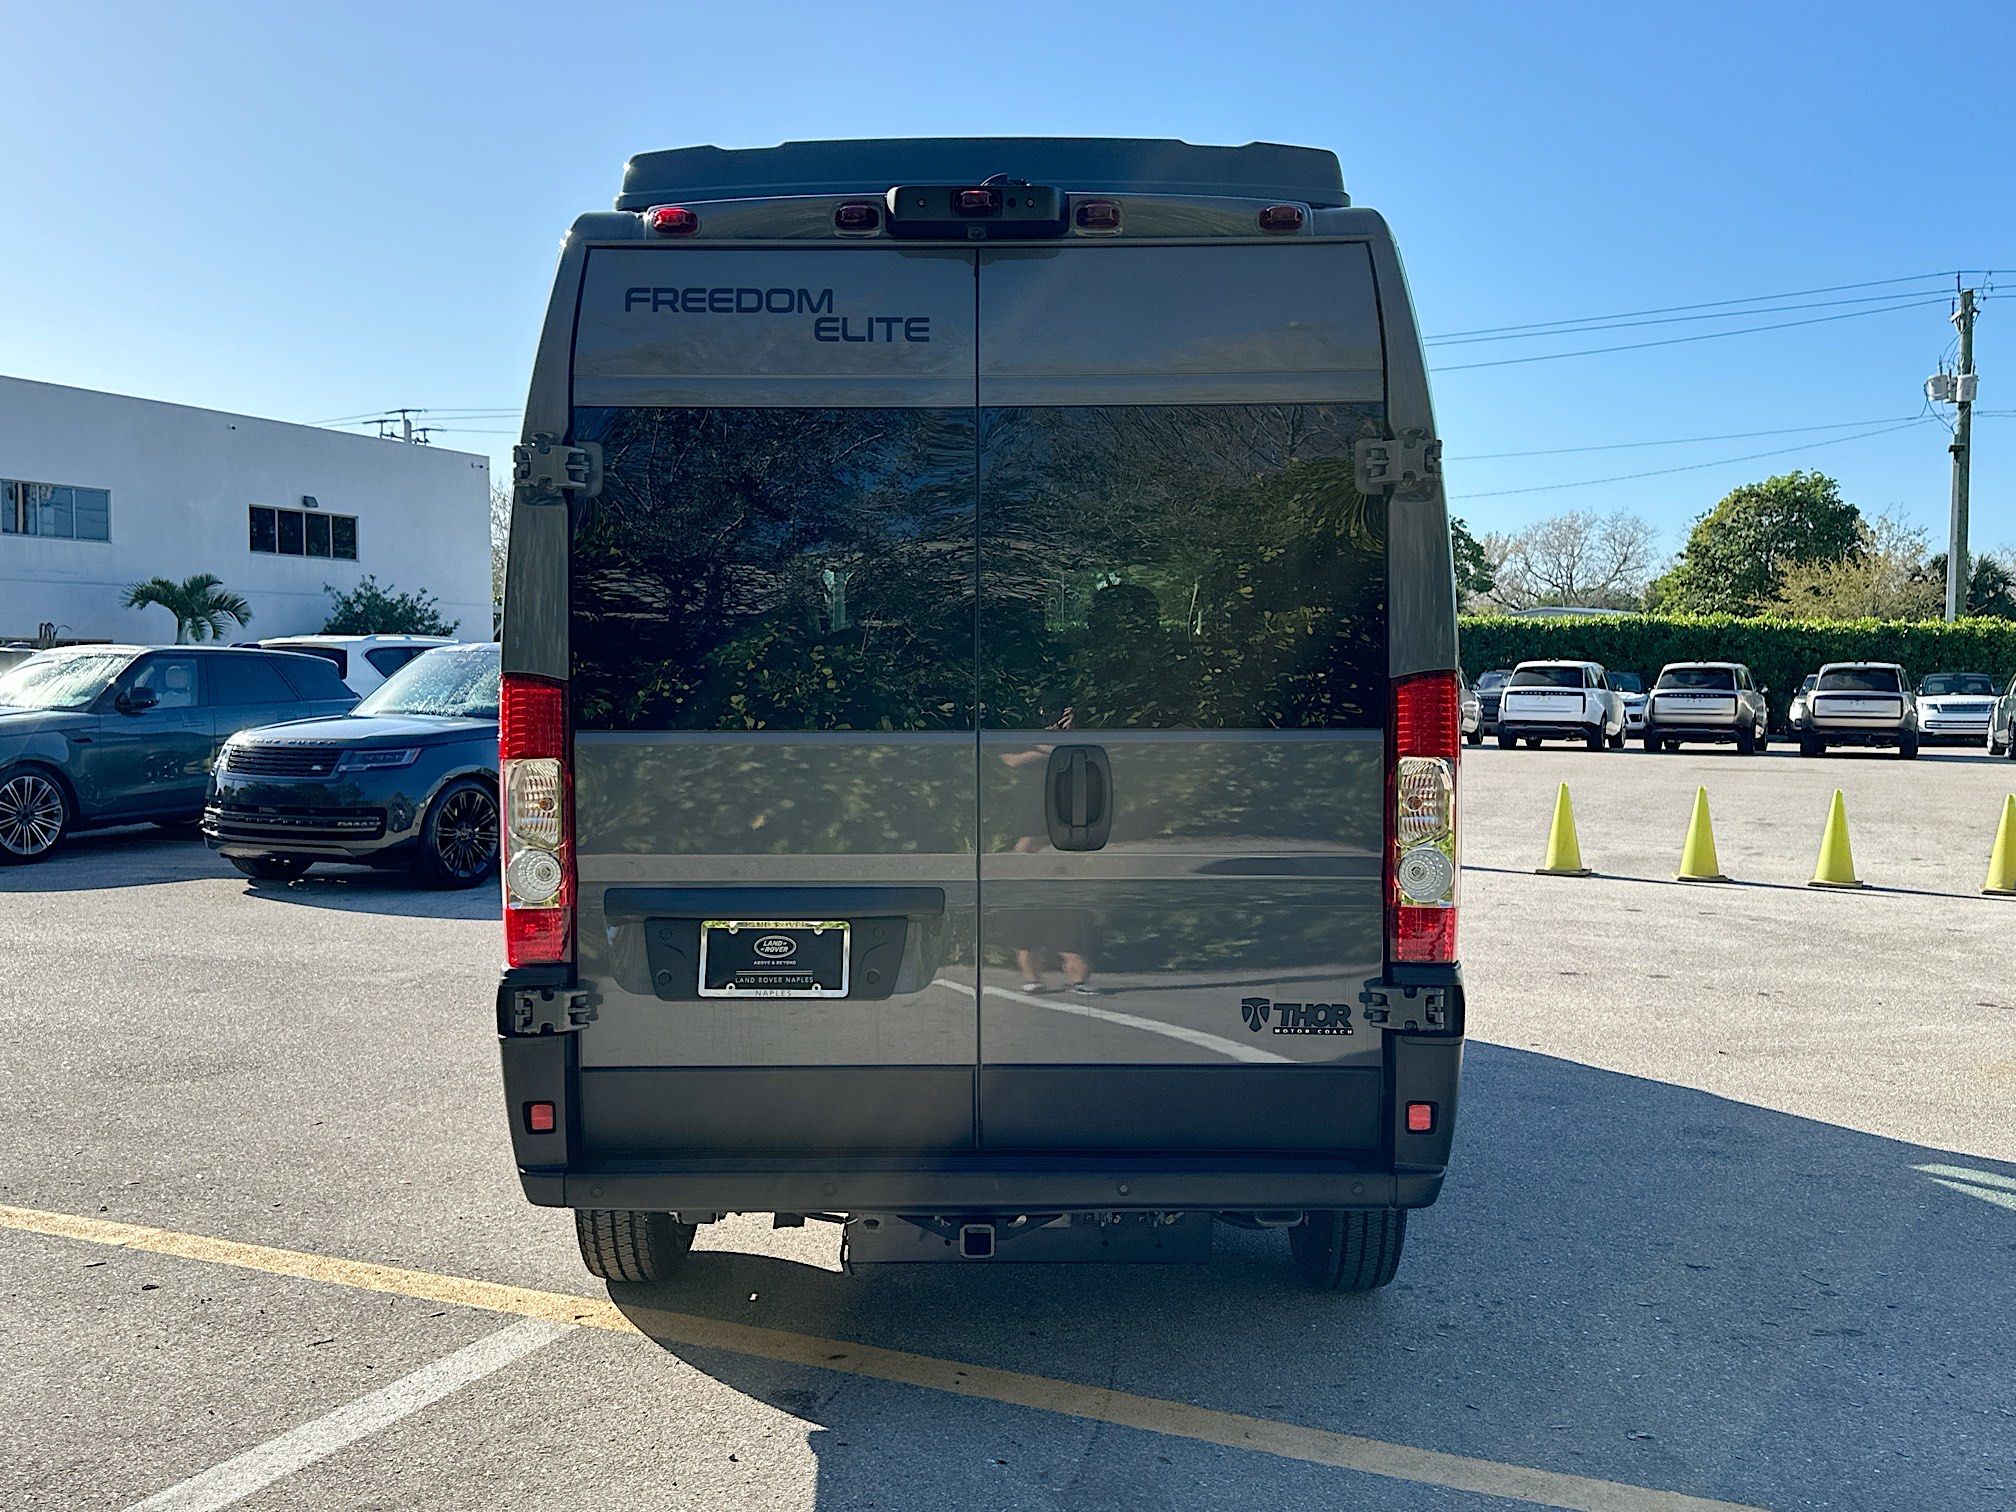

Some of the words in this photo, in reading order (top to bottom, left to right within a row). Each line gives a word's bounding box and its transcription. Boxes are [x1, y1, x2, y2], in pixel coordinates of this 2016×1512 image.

[624, 287, 834, 314] FREEDOM
[813, 316, 930, 343] ELITE
[735, 976, 756, 984] LAND
[758, 976, 783, 984] ROVER
[1273, 1003, 1353, 1028] THOR
